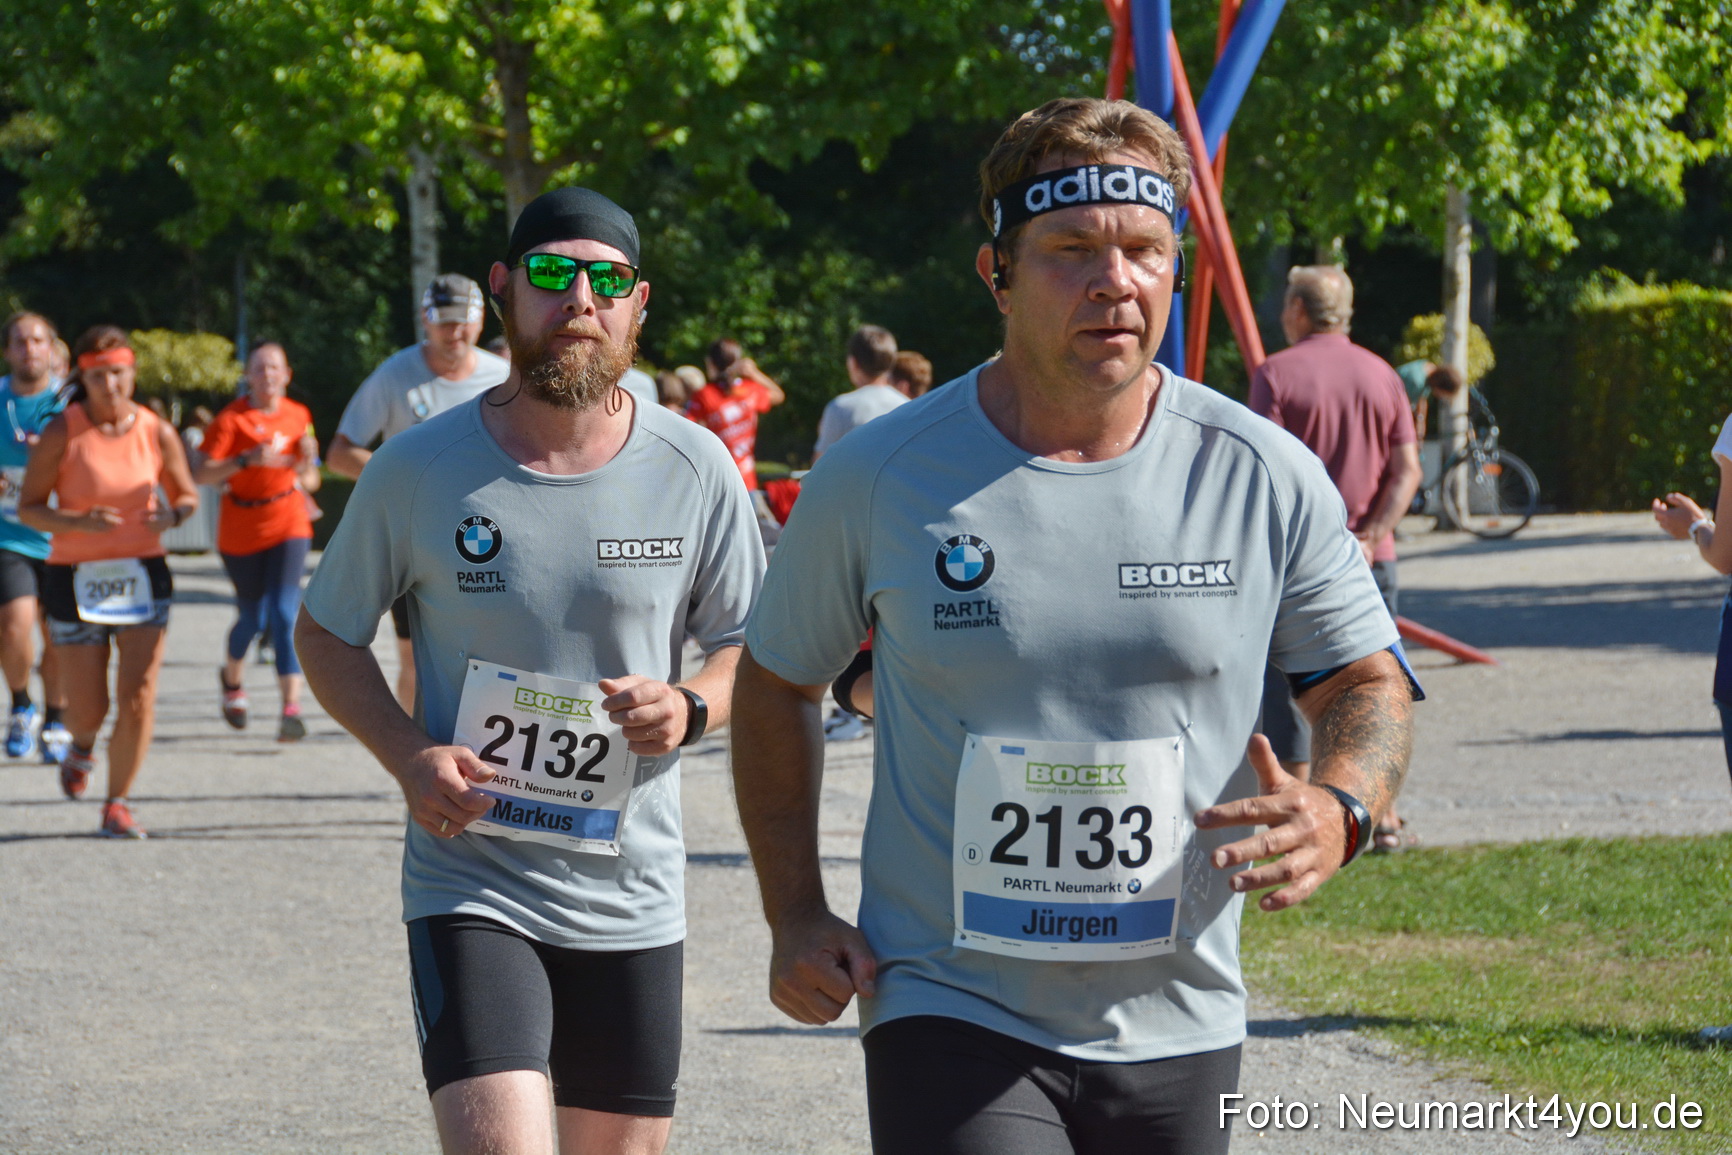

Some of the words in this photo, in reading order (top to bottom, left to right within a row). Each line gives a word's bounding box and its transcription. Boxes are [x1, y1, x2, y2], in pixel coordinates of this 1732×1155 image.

[1025, 166, 1175, 214] adidas
[458, 516, 499, 533] BMW
[597, 537, 684, 560] BOCK
[939, 535, 991, 555] BMW
[597, 561, 627, 569] inspired
[658, 559, 683, 568] concepts
[1118, 559, 1236, 589] BOCK
[456, 571, 506, 584] PARTL
[85, 577, 137, 599] 2097
[458, 583, 507, 594] Neumarkt
[1119, 590, 1157, 600] inspired
[1160, 590, 1171, 599] by
[1173, 590, 1199, 598] smart
[1202, 589, 1238, 598] concepts
[933, 600, 1000, 619] PARTL
[933, 616, 1000, 631] Neumarkt
[514, 686, 594, 717] BOCK
[512, 704, 538, 716] inspired
[547, 712, 565, 720] smart
[565, 716, 592, 724] concepts
[478, 714, 610, 784] 2132
[1026, 761, 1127, 786] BOCK
[492, 774, 522, 790] ARTL
[524, 781, 577, 799] Neumarkt
[1025, 784, 1057, 794] inspired
[1058, 786, 1068, 795] by
[1070, 787, 1094, 795] smart
[1095, 787, 1128, 796] concepts
[492, 797, 574, 831] Markus
[989, 801, 1153, 870] 2133
[968, 848, 976, 860] D
[1003, 877, 1051, 892] PARTL
[1054, 881, 1122, 894] Neumarkt
[1021, 908, 1118, 942] Jürgen
